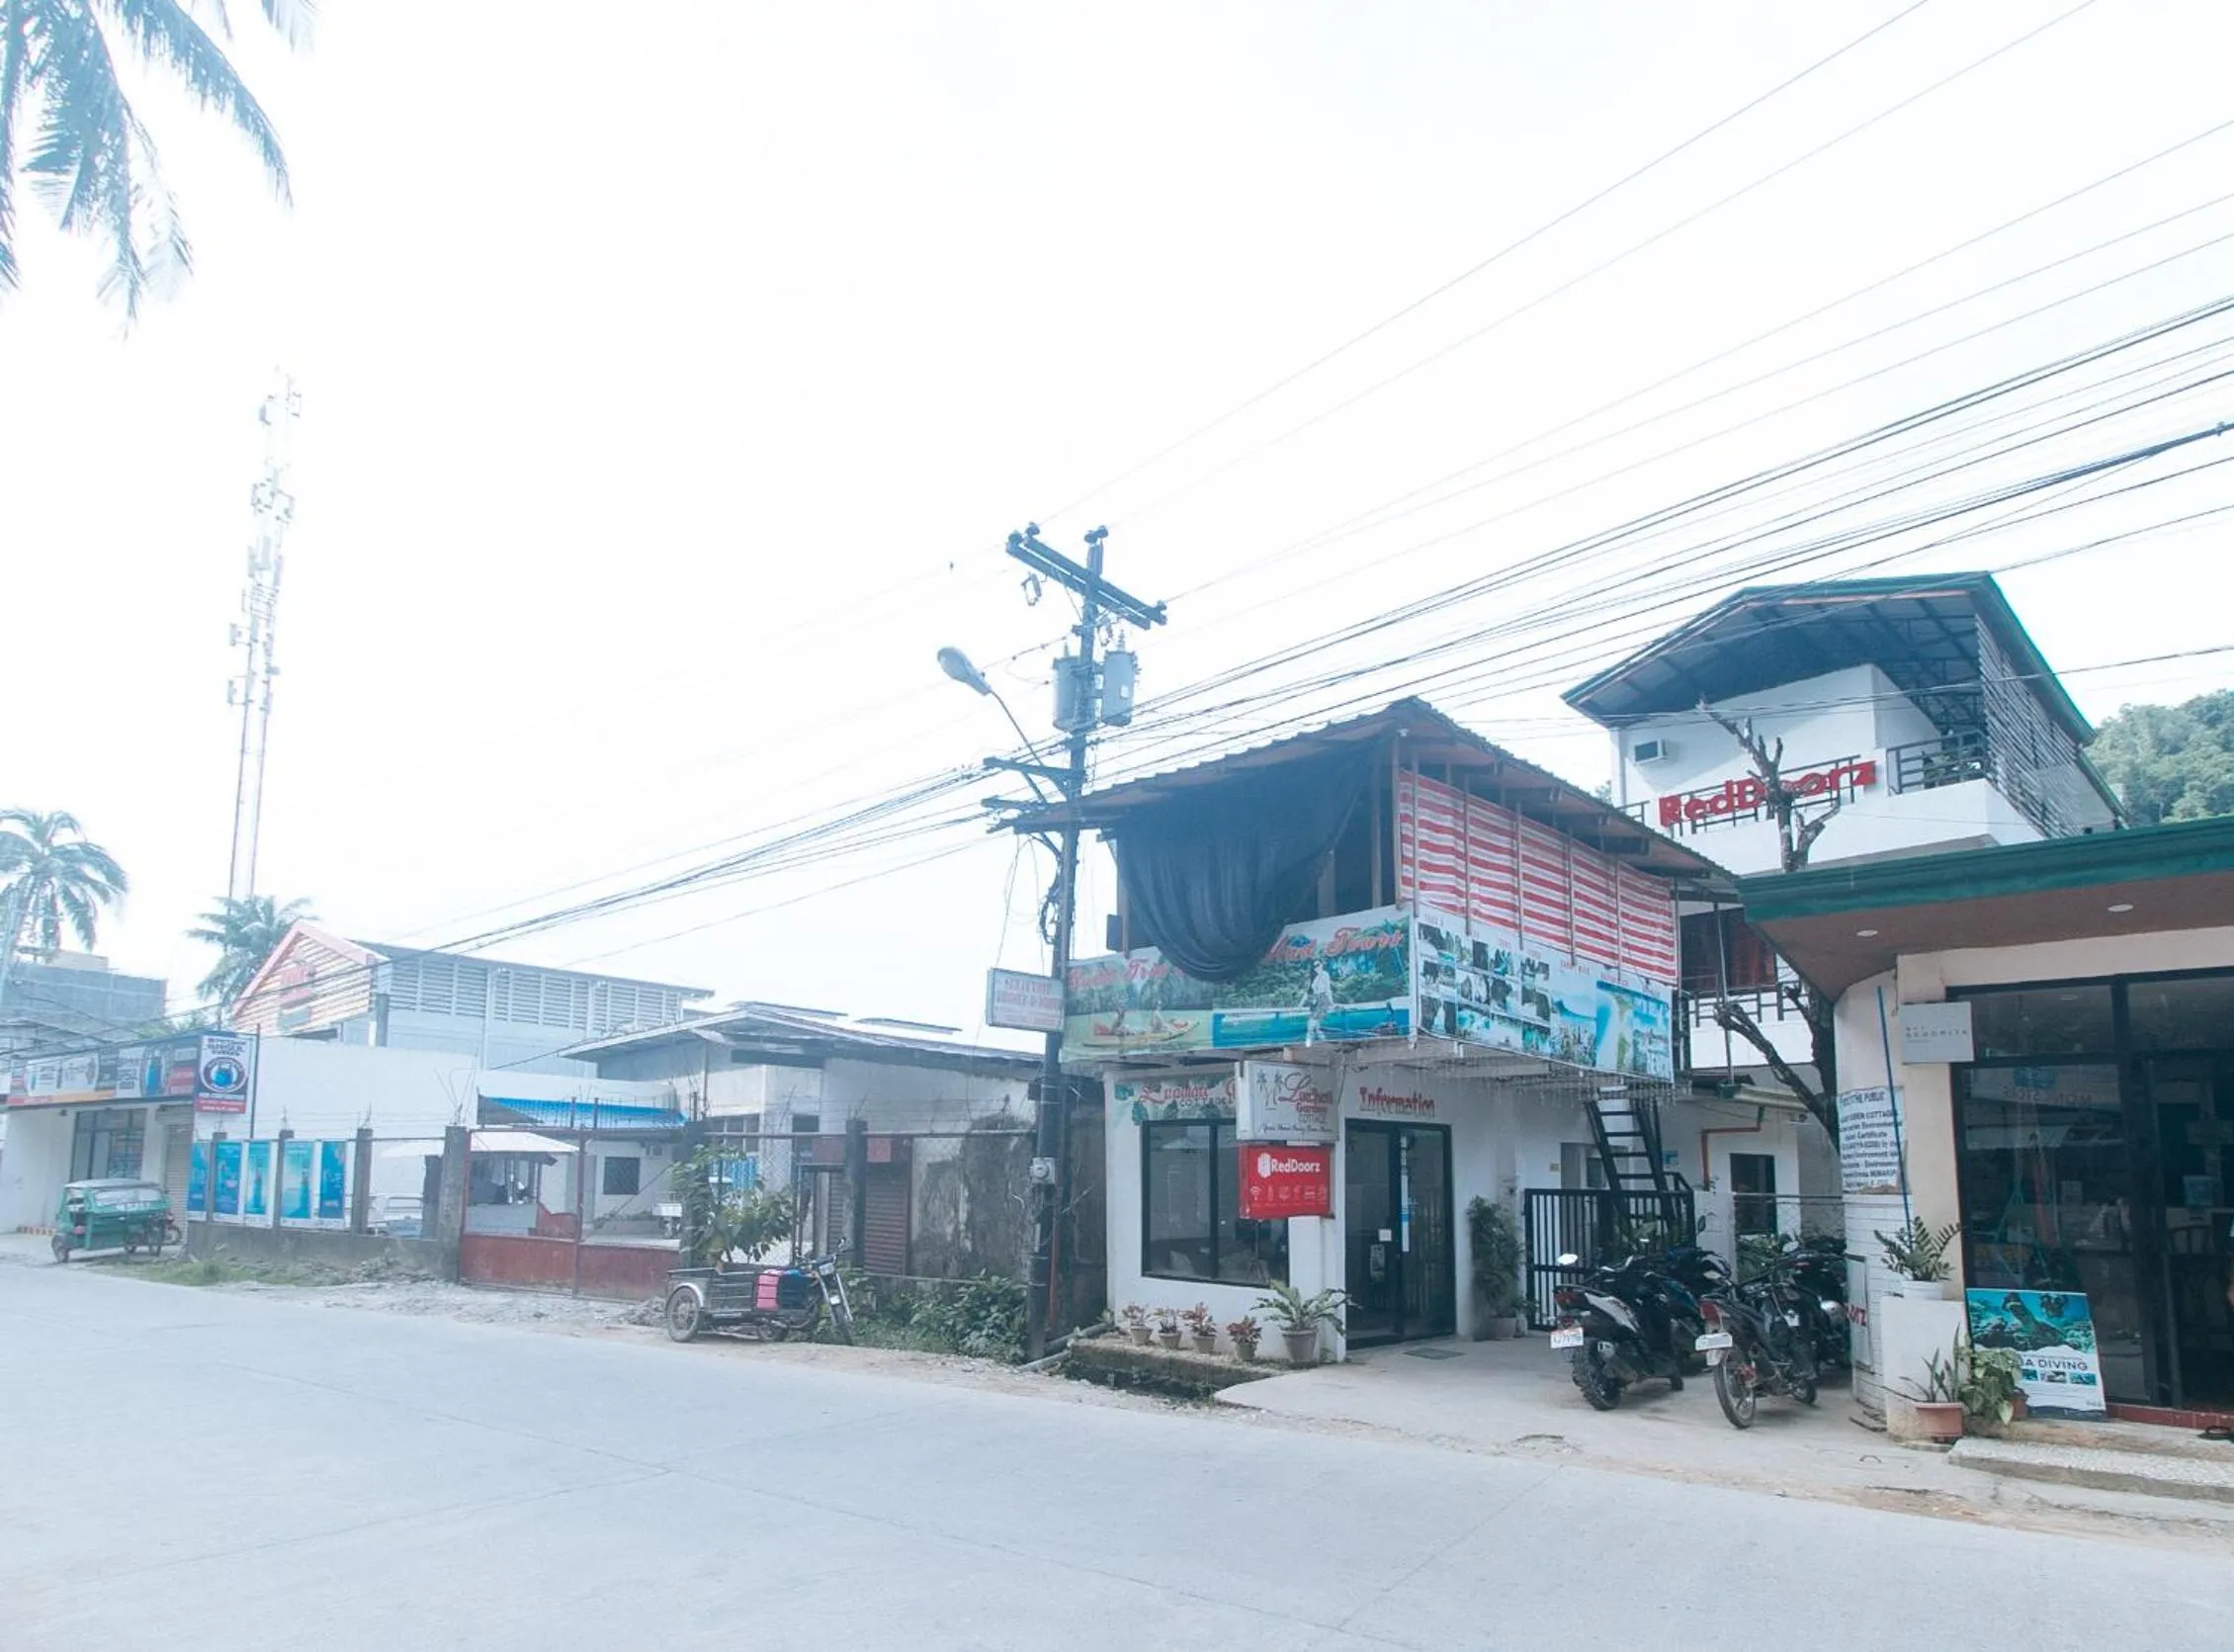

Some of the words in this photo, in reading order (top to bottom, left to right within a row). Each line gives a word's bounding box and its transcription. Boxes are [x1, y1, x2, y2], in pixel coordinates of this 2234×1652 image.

[1660, 760, 1876, 828] RedDorz
[1270, 1158, 1322, 1173] RedDoorz
[2037, 1358, 2089, 1371] DIVING
